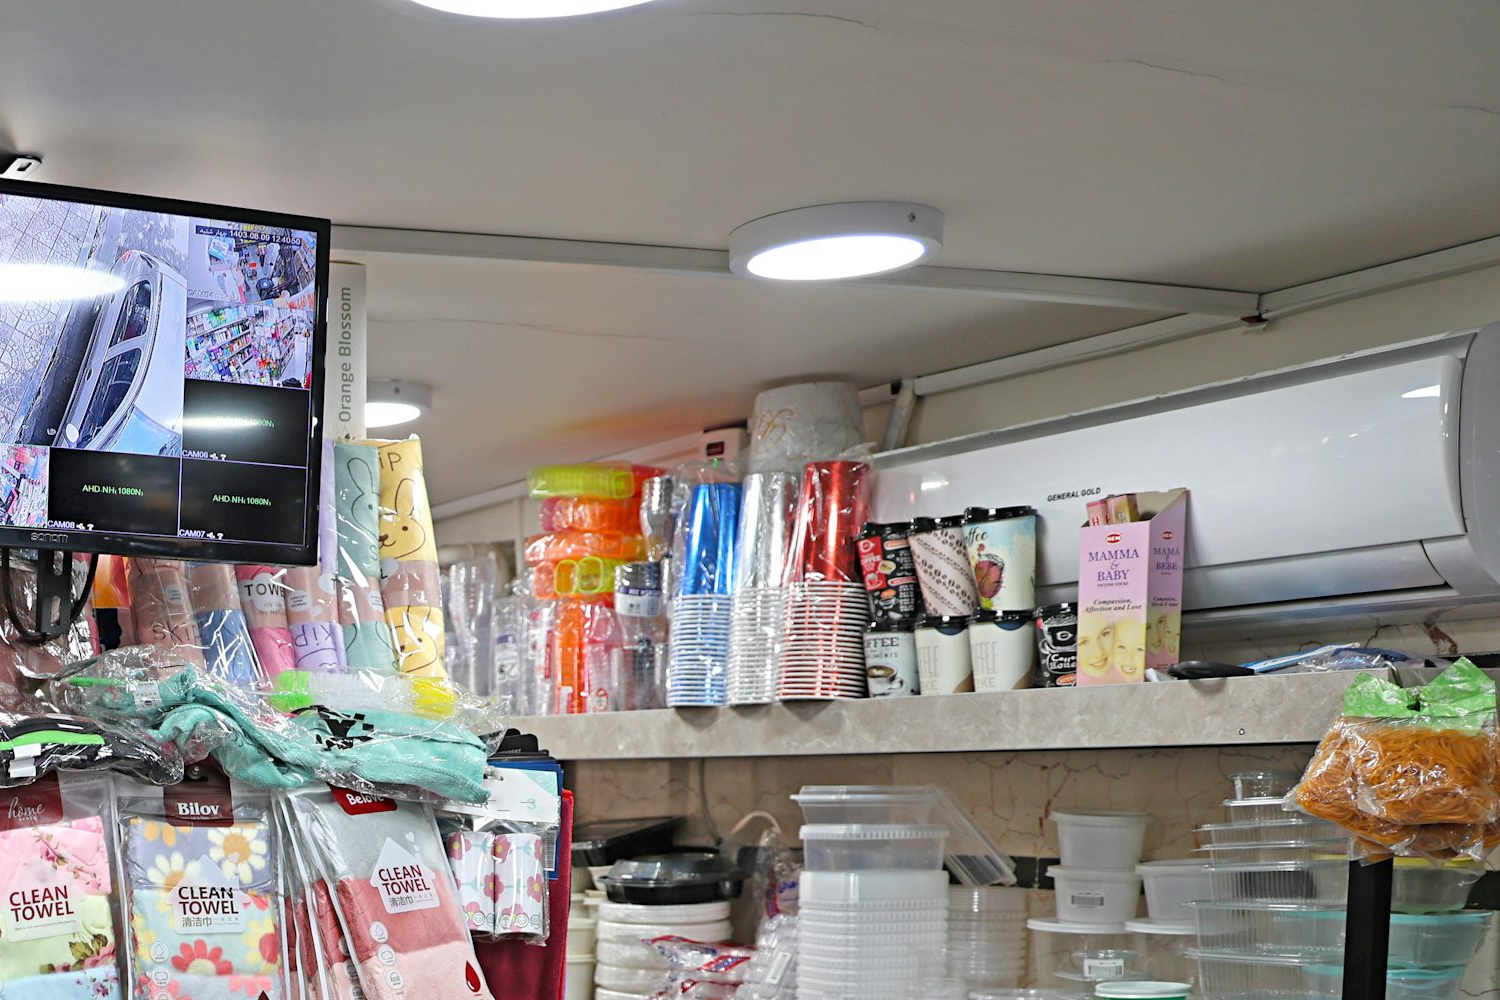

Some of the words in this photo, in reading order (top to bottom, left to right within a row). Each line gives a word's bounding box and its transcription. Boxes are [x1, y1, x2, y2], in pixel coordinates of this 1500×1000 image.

[338, 286, 352, 357] Blossom
[338, 362, 354, 422] Orange
[182, 450, 209, 459] CAM06
[1047, 490, 1080, 502] GENERAL
[1080, 487, 1102, 499] GOLD
[47, 520, 76, 530] CAM08
[179, 529, 206, 539] CAM07
[1088, 549, 1140, 562] MAMMA
[1097, 569, 1130, 581] BABY
[1084, 605, 1112, 613] Affection
[7, 796, 45, 819] home
[177, 802, 220, 816] Bilov
[378, 864, 423, 882] CLEAN
[178, 886, 234, 899] CLEAN
[382, 877, 430, 896] TOWEL
[9, 885, 69, 907] CLEAN
[11, 901, 74, 922] TOWEL
[178, 901, 239, 915] TOWEL
[182, 917, 213, 928] 清洁巾
